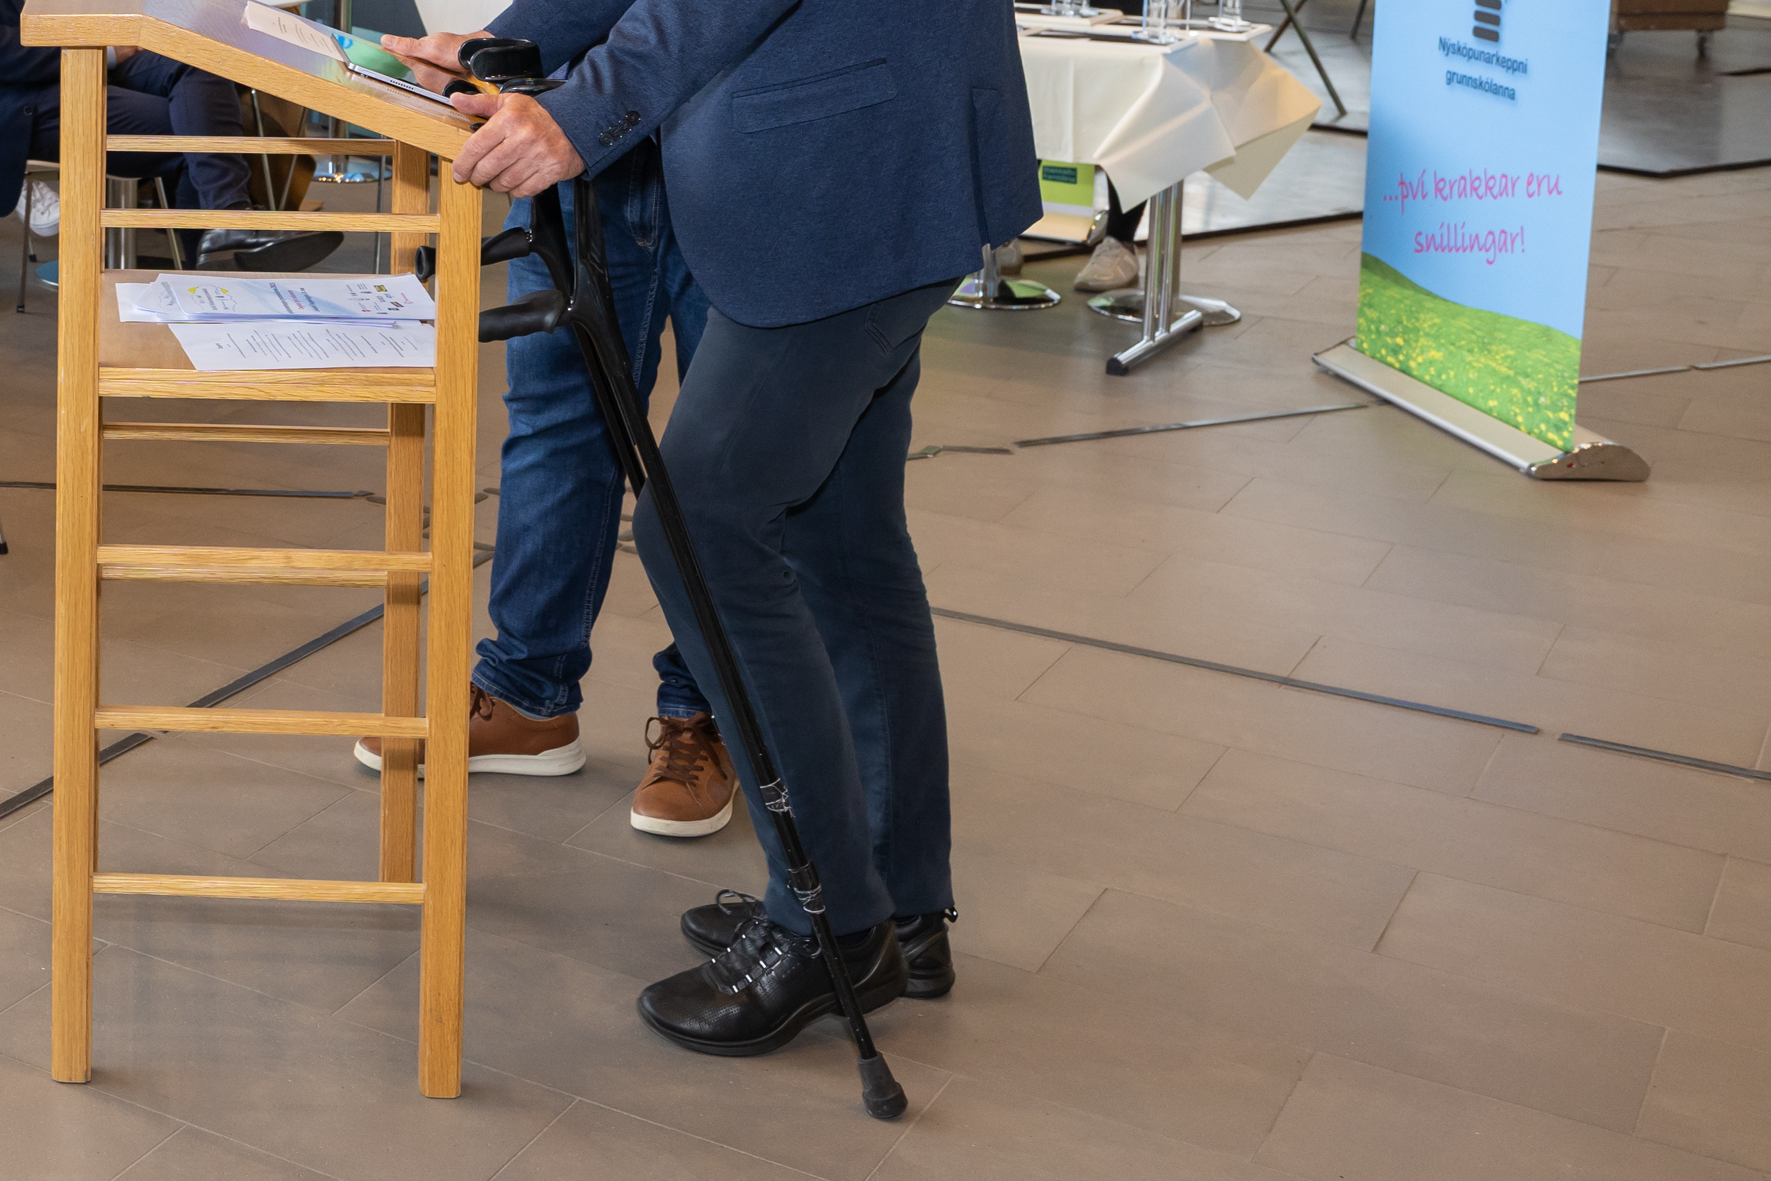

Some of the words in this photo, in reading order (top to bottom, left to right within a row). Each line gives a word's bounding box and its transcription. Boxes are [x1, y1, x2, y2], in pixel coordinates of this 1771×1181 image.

[1438, 35, 1528, 75] Nýsköpunarkeppni
[1445, 69, 1516, 101] grunnskólanna
[1434, 168, 1520, 202] krakkar
[1525, 173, 1563, 198] eru
